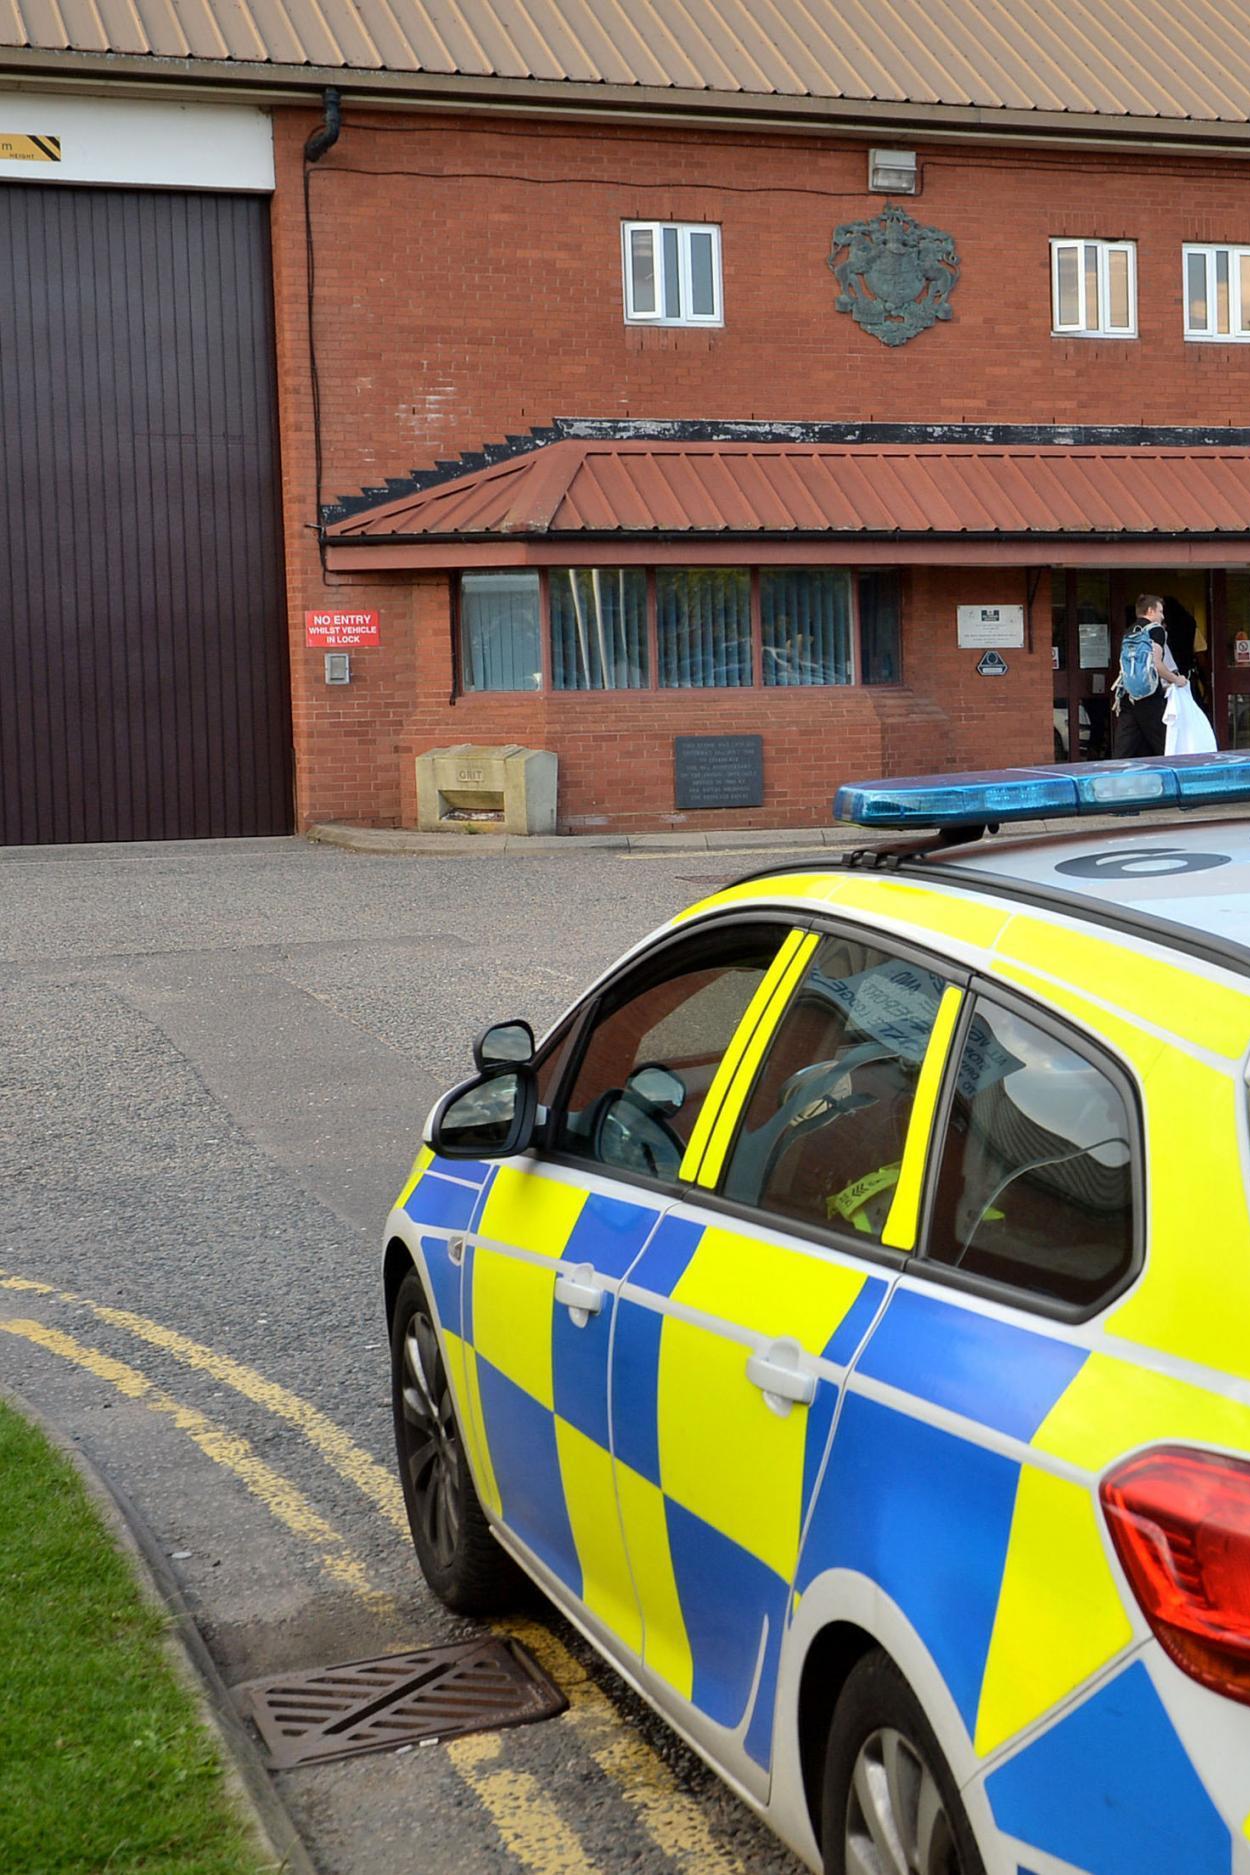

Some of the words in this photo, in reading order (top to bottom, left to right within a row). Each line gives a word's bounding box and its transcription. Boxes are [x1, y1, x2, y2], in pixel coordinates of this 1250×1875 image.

[313, 615, 331, 625] NO
[333, 614, 371, 625] ENTRY
[308, 626, 340, 635] WHILST
[341, 625, 377, 634] VEHICLE
[326, 636, 336, 644] IN
[337, 635, 361, 644] LOCK
[459, 770, 482, 780] GRIT
